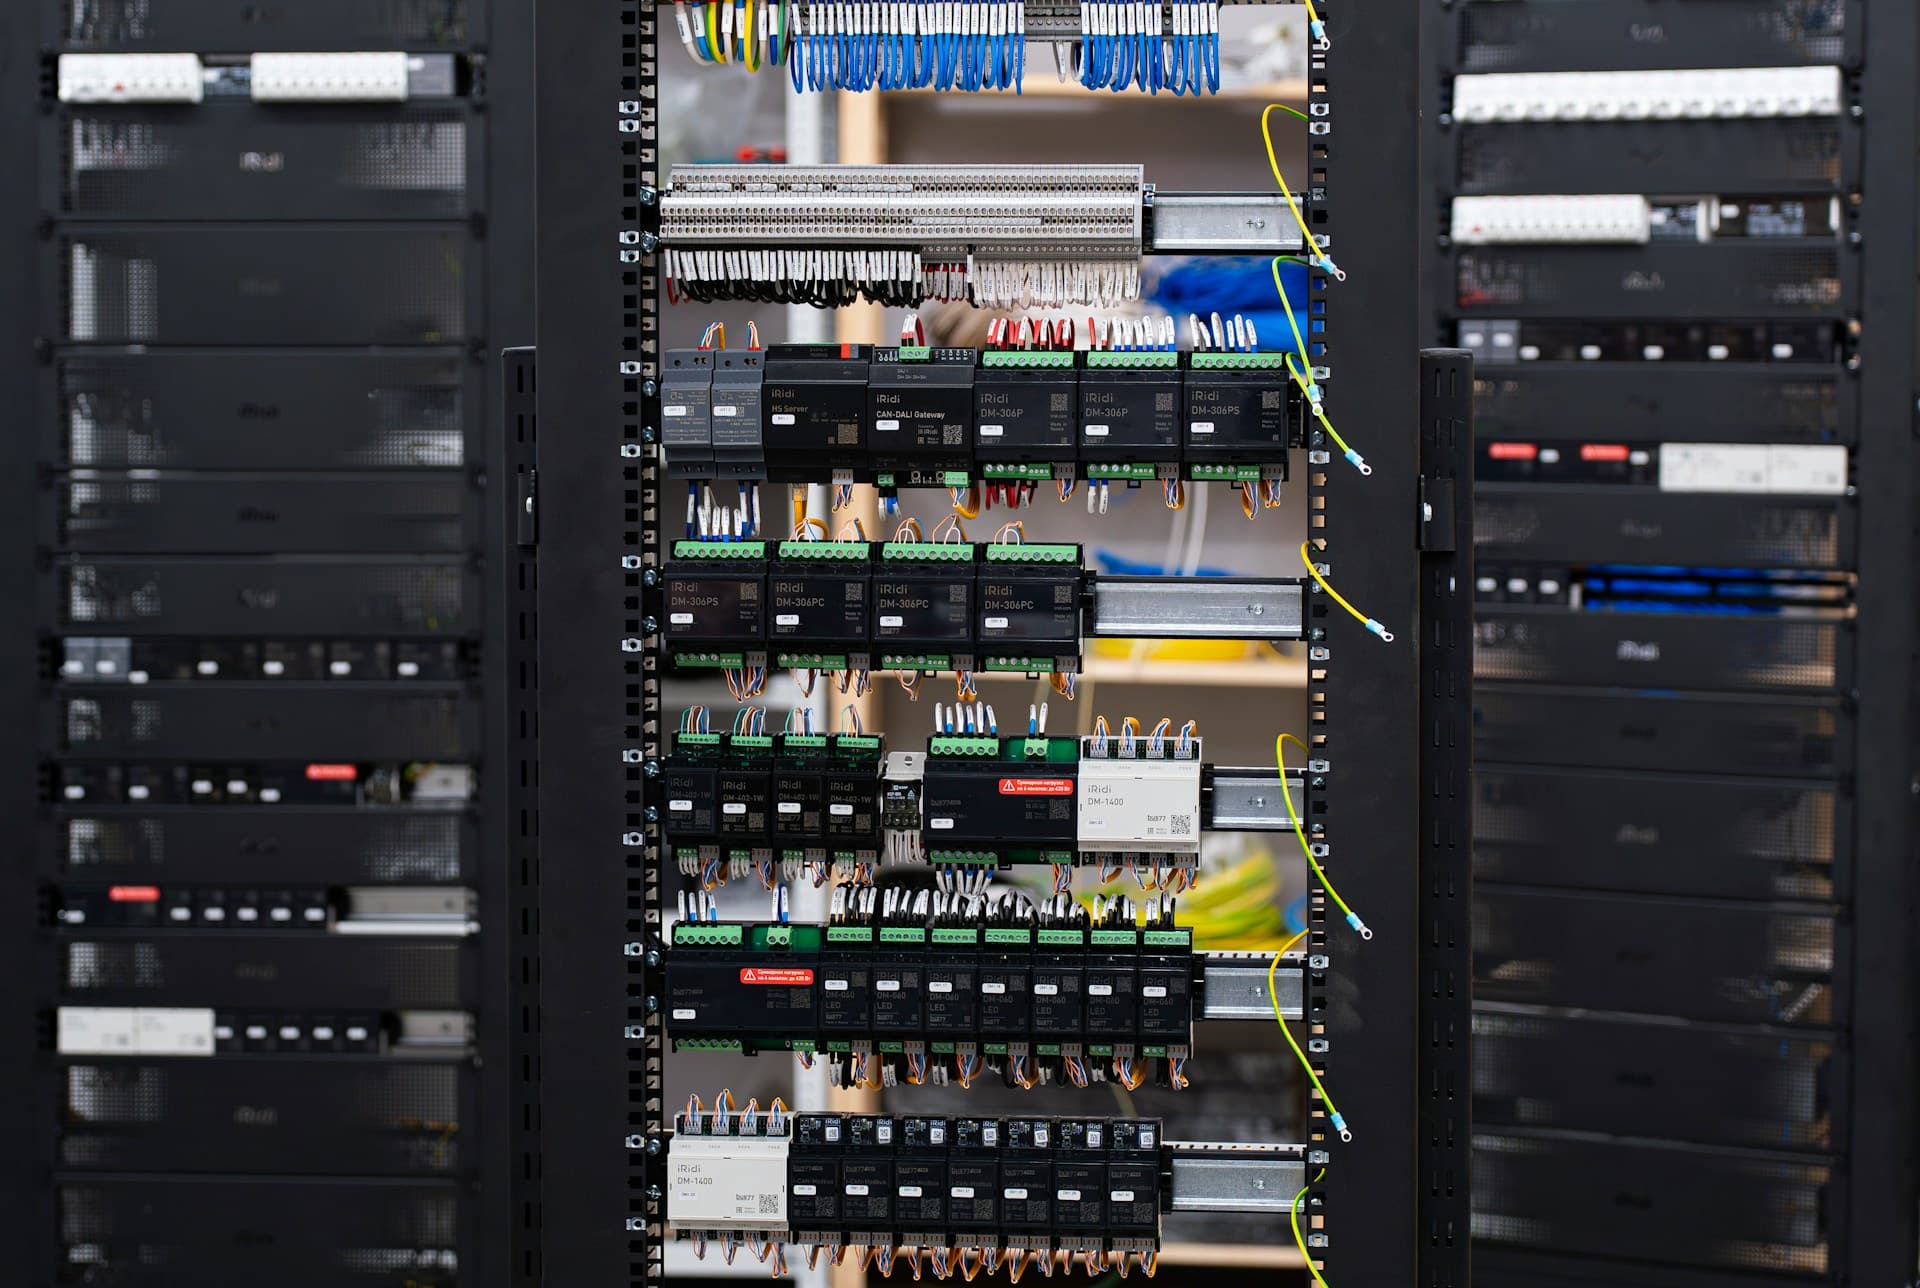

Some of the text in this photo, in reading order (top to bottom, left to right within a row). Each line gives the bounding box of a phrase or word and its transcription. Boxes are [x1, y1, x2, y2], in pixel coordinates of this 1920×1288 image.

[771, 389, 795, 398] iRidi
[1085, 392, 1113, 403] iRidi
[1191, 391, 1219, 401] iRidi
[876, 394, 900, 403] iRidi
[980, 393, 1009, 404] iRidi
[784, 405, 809, 413] Server
[980, 408, 1024, 418] DM-306P
[1085, 408, 1128, 417] DM-306P
[1191, 406, 1240, 415] DM-306PS
[876, 410, 945, 420] CAN-DALI Gateway
[671, 582, 698, 592] iRidi
[776, 582, 804, 593] iRidi
[880, 584, 908, 594] iRidi
[984, 585, 1013, 596] iRidi
[671, 597, 719, 606] DM-306PS
[776, 598, 825, 607] DM-306PC
[880, 599, 929, 609] DM-306PC
[984, 600, 1034, 610] DM-306PC
[723, 781, 746, 790] iRidi
[778, 780, 801, 789] iRidi
[830, 782, 853, 791] iRidi
[1088, 785, 1112, 793] iRidi
[1088, 798, 1124, 806] DM-1400
[677, 1164, 701, 1173] iRidi
[677, 1177, 713, 1185] DM-1400
